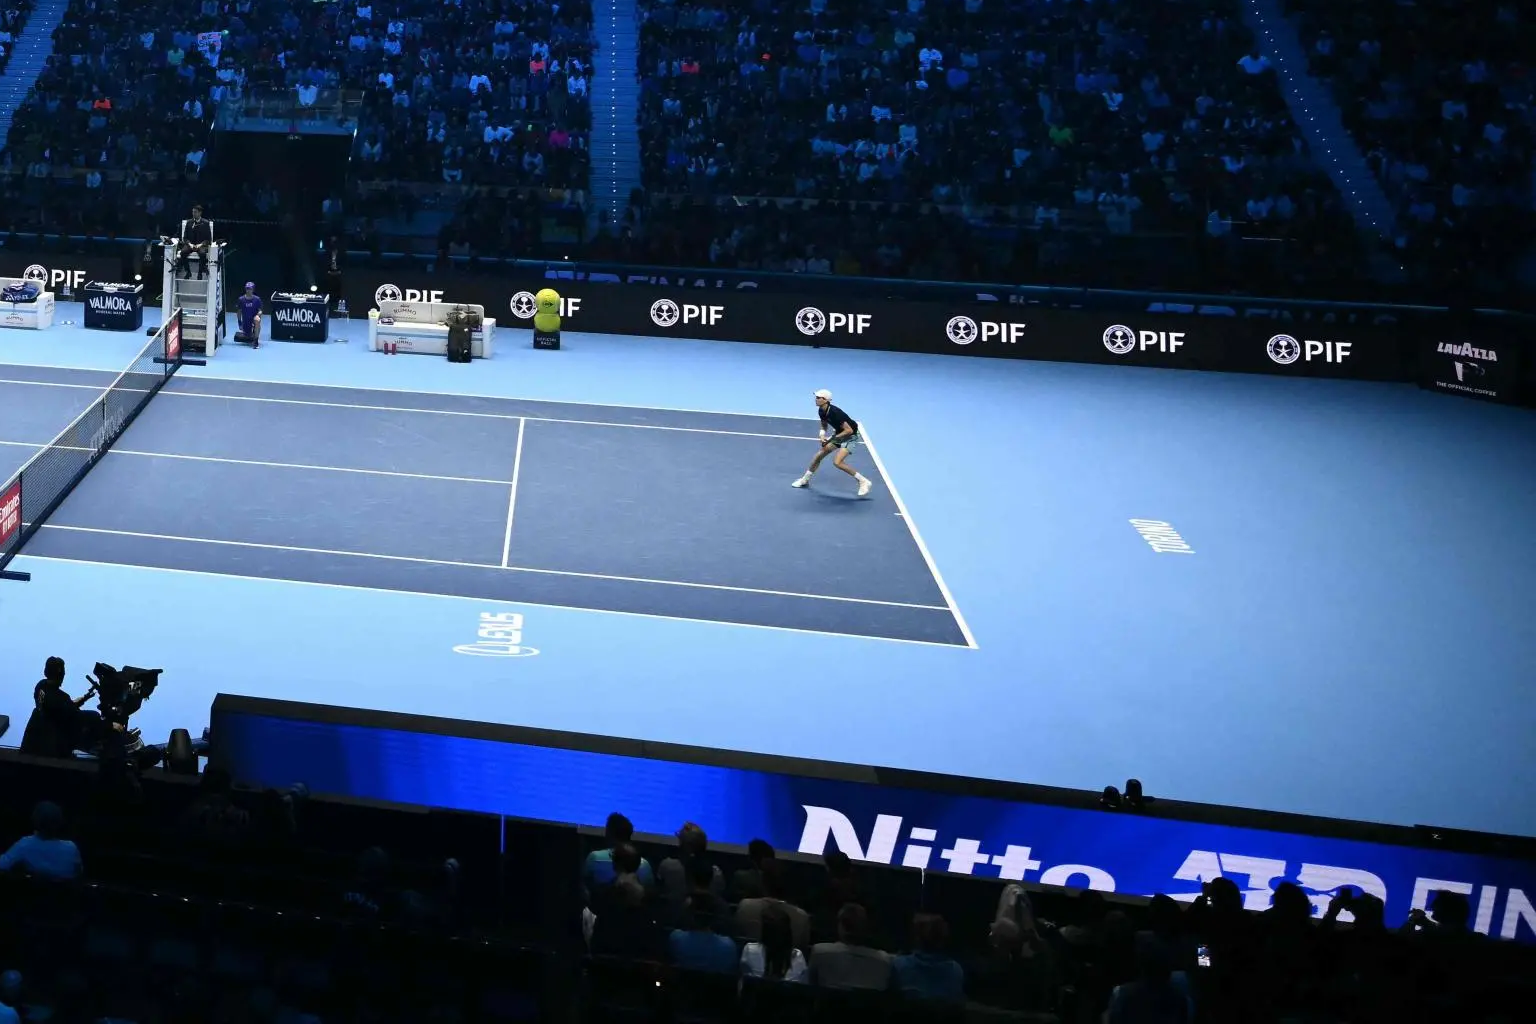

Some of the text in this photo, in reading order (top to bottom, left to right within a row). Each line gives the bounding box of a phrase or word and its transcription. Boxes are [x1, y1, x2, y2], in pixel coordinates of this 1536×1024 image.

[51, 269, 87, 288] PIF
[89, 296, 132, 312] VALMORA
[560, 298, 581, 316] IF
[275, 309, 320, 324] VALMORA
[683, 305, 724, 325] PIF
[830, 313, 871, 333] PIF
[981, 322, 1025, 343] PIF
[1140, 331, 1185, 352] PIF
[1305, 341, 1352, 362] PIF
[1437, 342, 1497, 363] LAVAZZA
